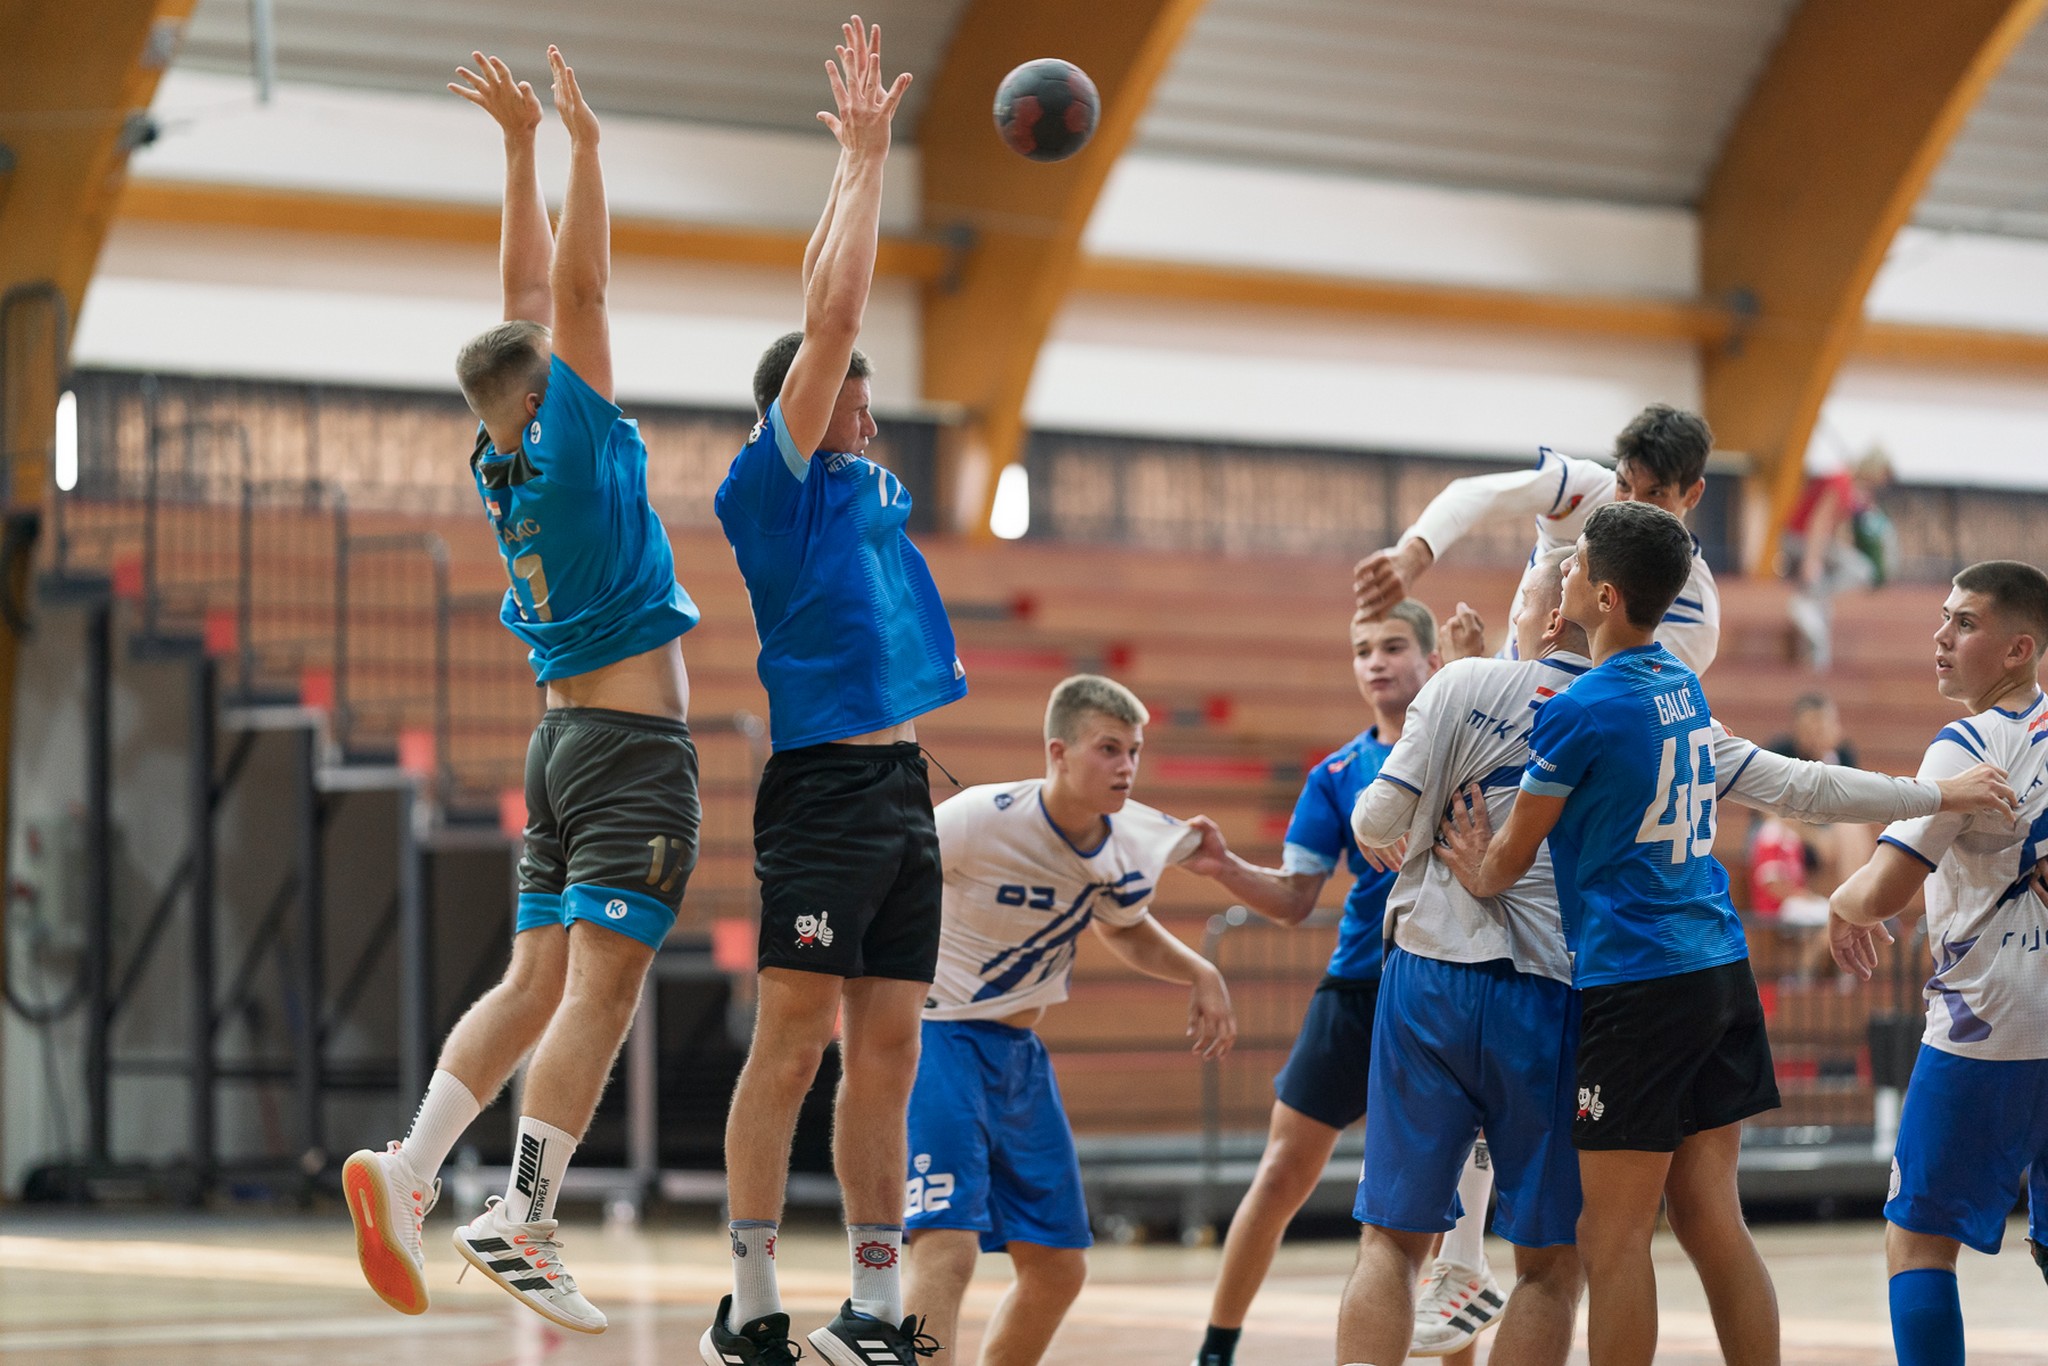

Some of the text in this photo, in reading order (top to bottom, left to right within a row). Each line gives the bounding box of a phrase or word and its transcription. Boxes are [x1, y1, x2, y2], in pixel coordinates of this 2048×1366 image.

[1654, 681, 1696, 726] GALIĆ
[1635, 727, 1717, 864] 46
[516, 1133, 540, 1199] PUMA
[531, 1177, 550, 1223] ORTSWEAR
